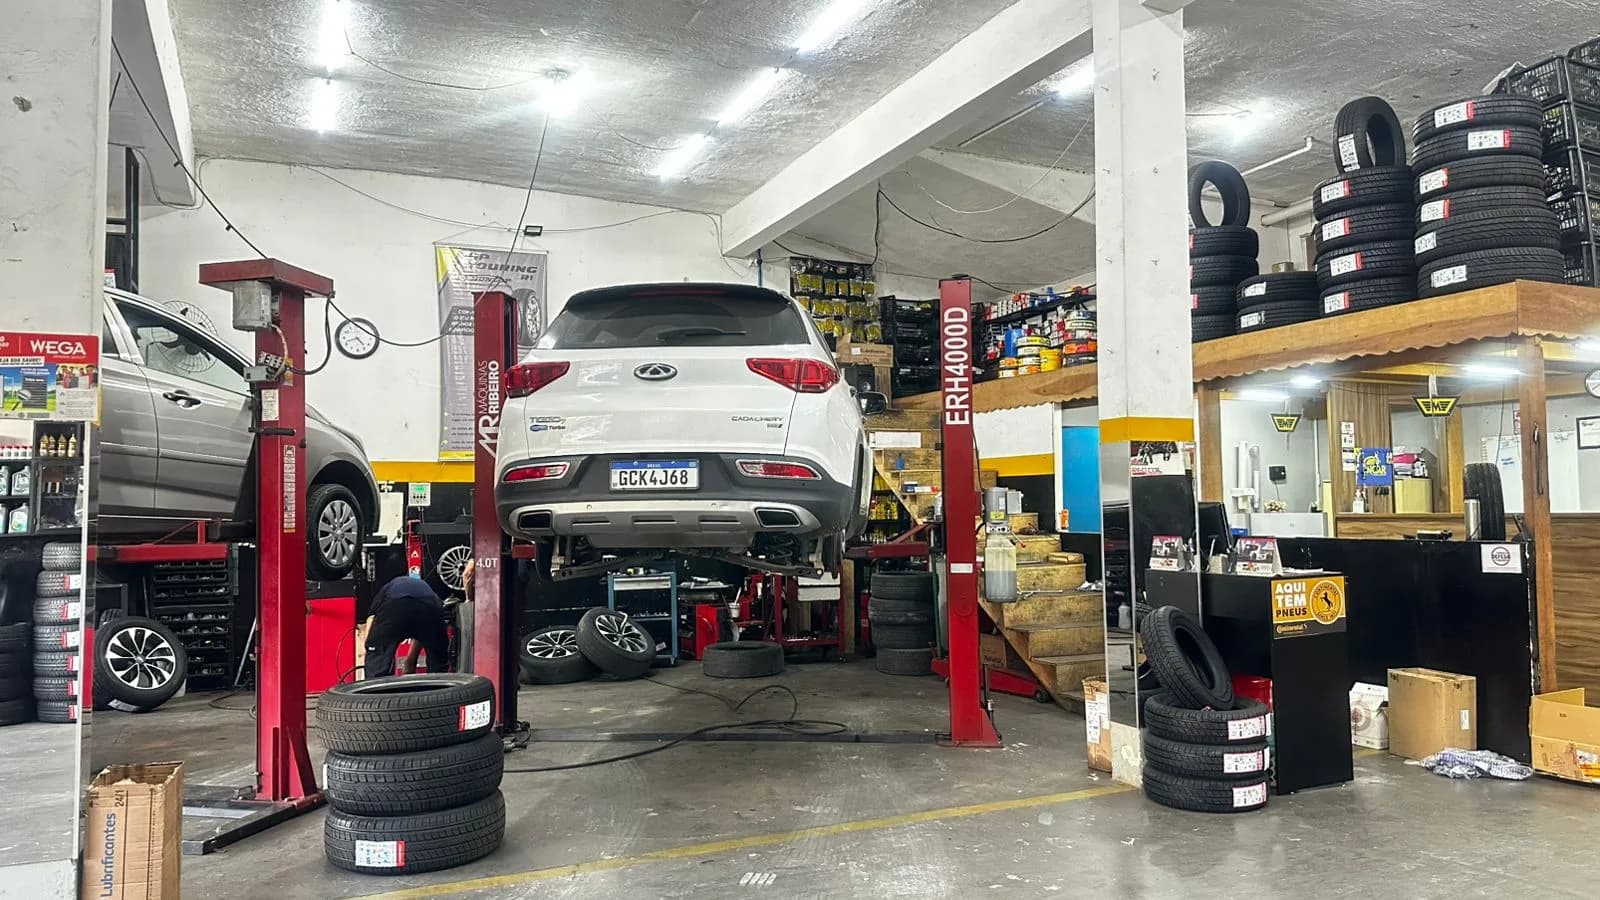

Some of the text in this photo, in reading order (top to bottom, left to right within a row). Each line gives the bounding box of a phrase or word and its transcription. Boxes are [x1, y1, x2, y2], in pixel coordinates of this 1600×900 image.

[30, 339, 86, 355] WEGA
[944, 307, 970, 425] ERH4000D
[488, 360, 500, 414] RIBEIRO
[619, 469, 689, 486] GCK4J68
[476, 557, 499, 569] 4.0T
[1276, 582, 1306, 594] AQUI
[1275, 594, 1308, 608] TEM
[1276, 607, 1308, 618] PNEUS
[114, 789, 126, 808] 24/1
[101, 812, 117, 898] Lubrificantes
